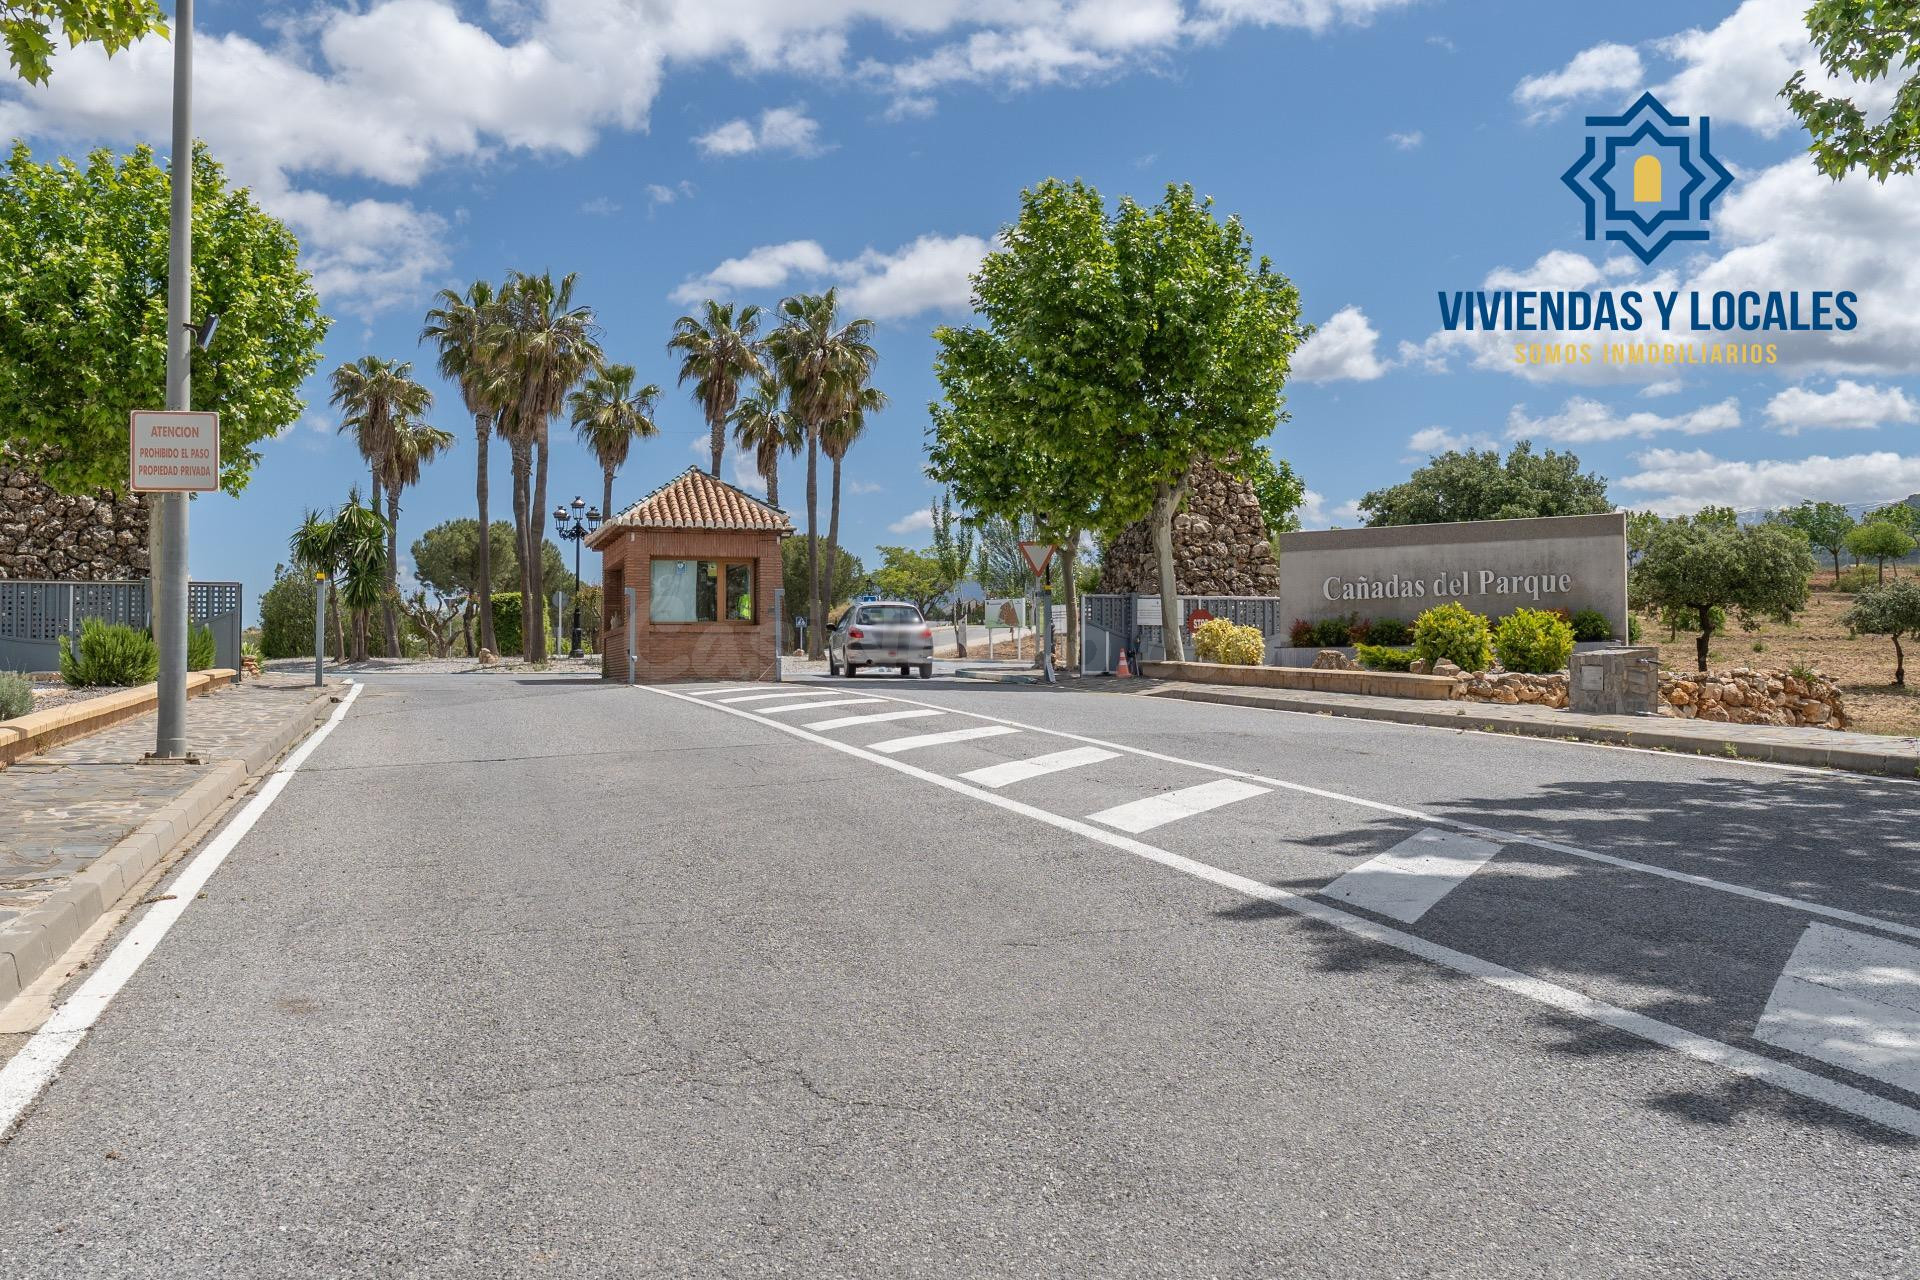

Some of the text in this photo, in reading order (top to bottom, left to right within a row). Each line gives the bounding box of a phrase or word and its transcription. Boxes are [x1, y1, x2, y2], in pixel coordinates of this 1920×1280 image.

[150, 426, 200, 438] ATENCION
[139, 447, 210, 459] PROHIBIDO EL PASO
[138, 465, 211, 476] PROPIEDAD PRIVADA
[1323, 570, 1572, 601] Cañadas del Parque
